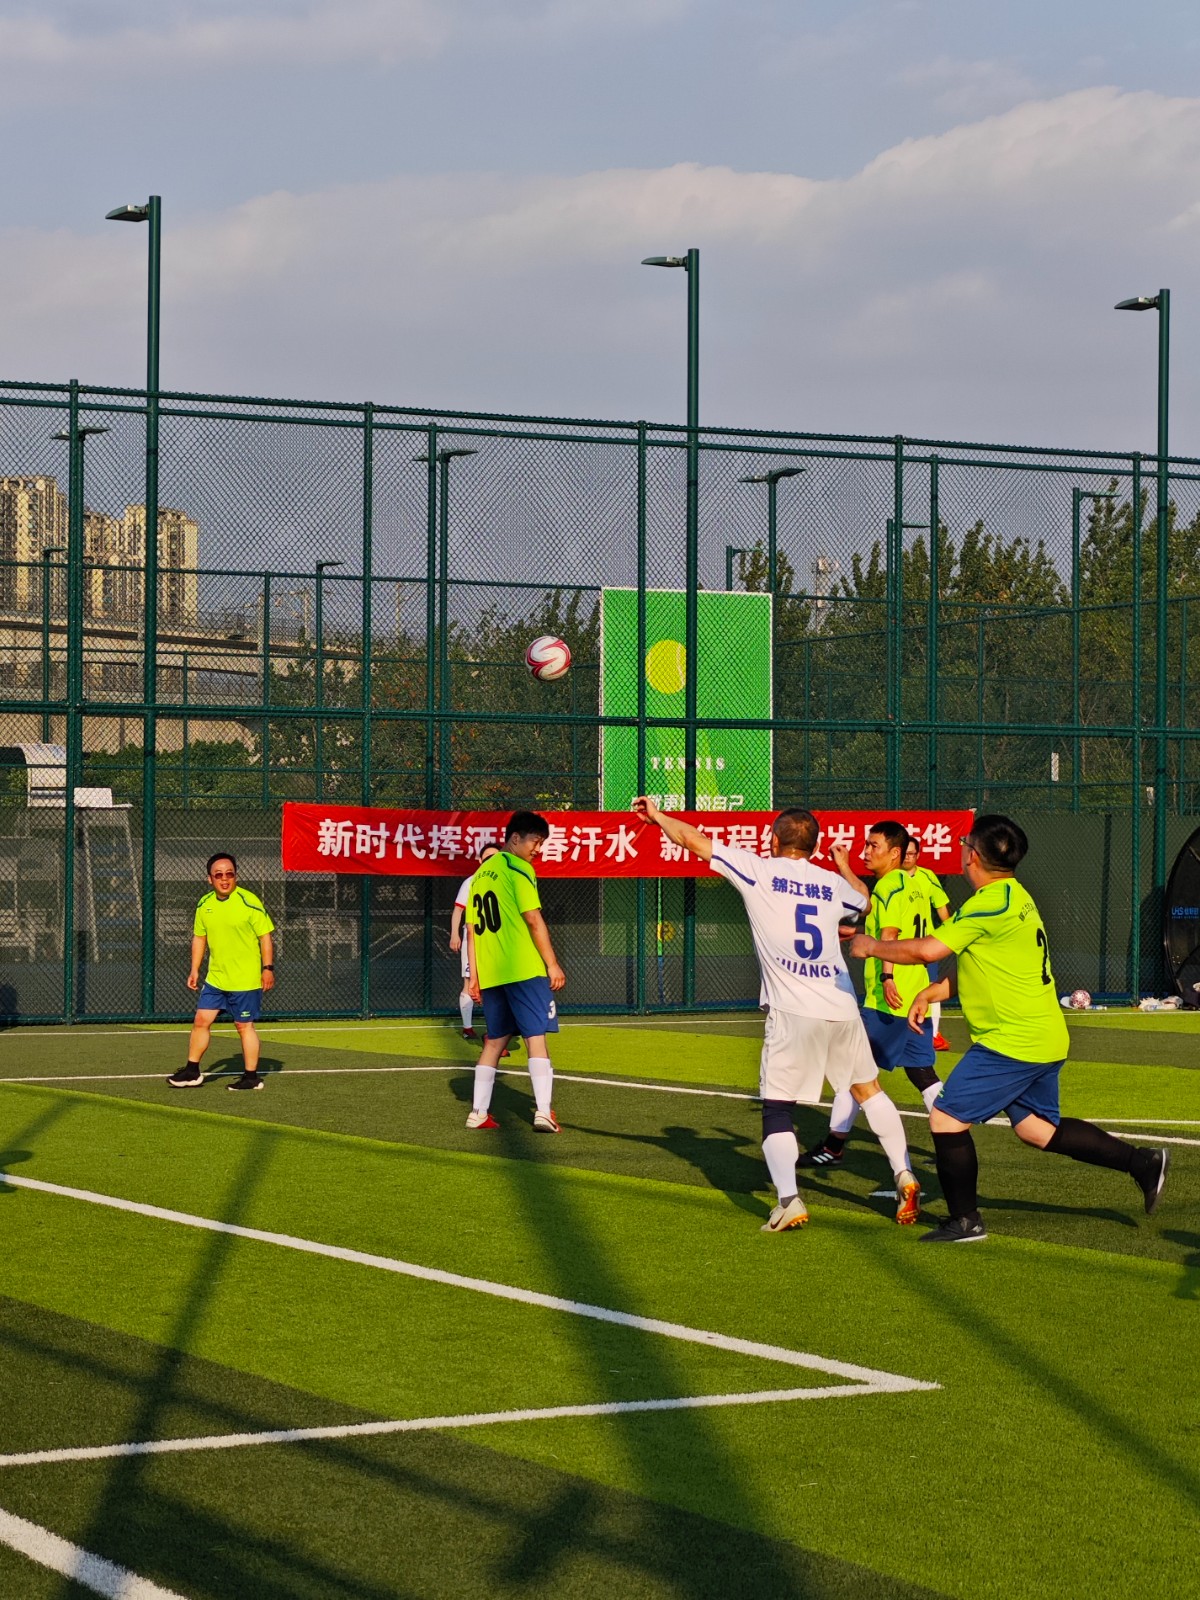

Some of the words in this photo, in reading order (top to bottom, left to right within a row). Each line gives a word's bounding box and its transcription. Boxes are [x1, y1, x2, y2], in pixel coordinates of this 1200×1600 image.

[316, 817, 639, 863] 新时代挥洒春汗水
[771, 876, 834, 902] 锦江税务
[472, 890, 502, 936] 30
[793, 903, 824, 961] 5
